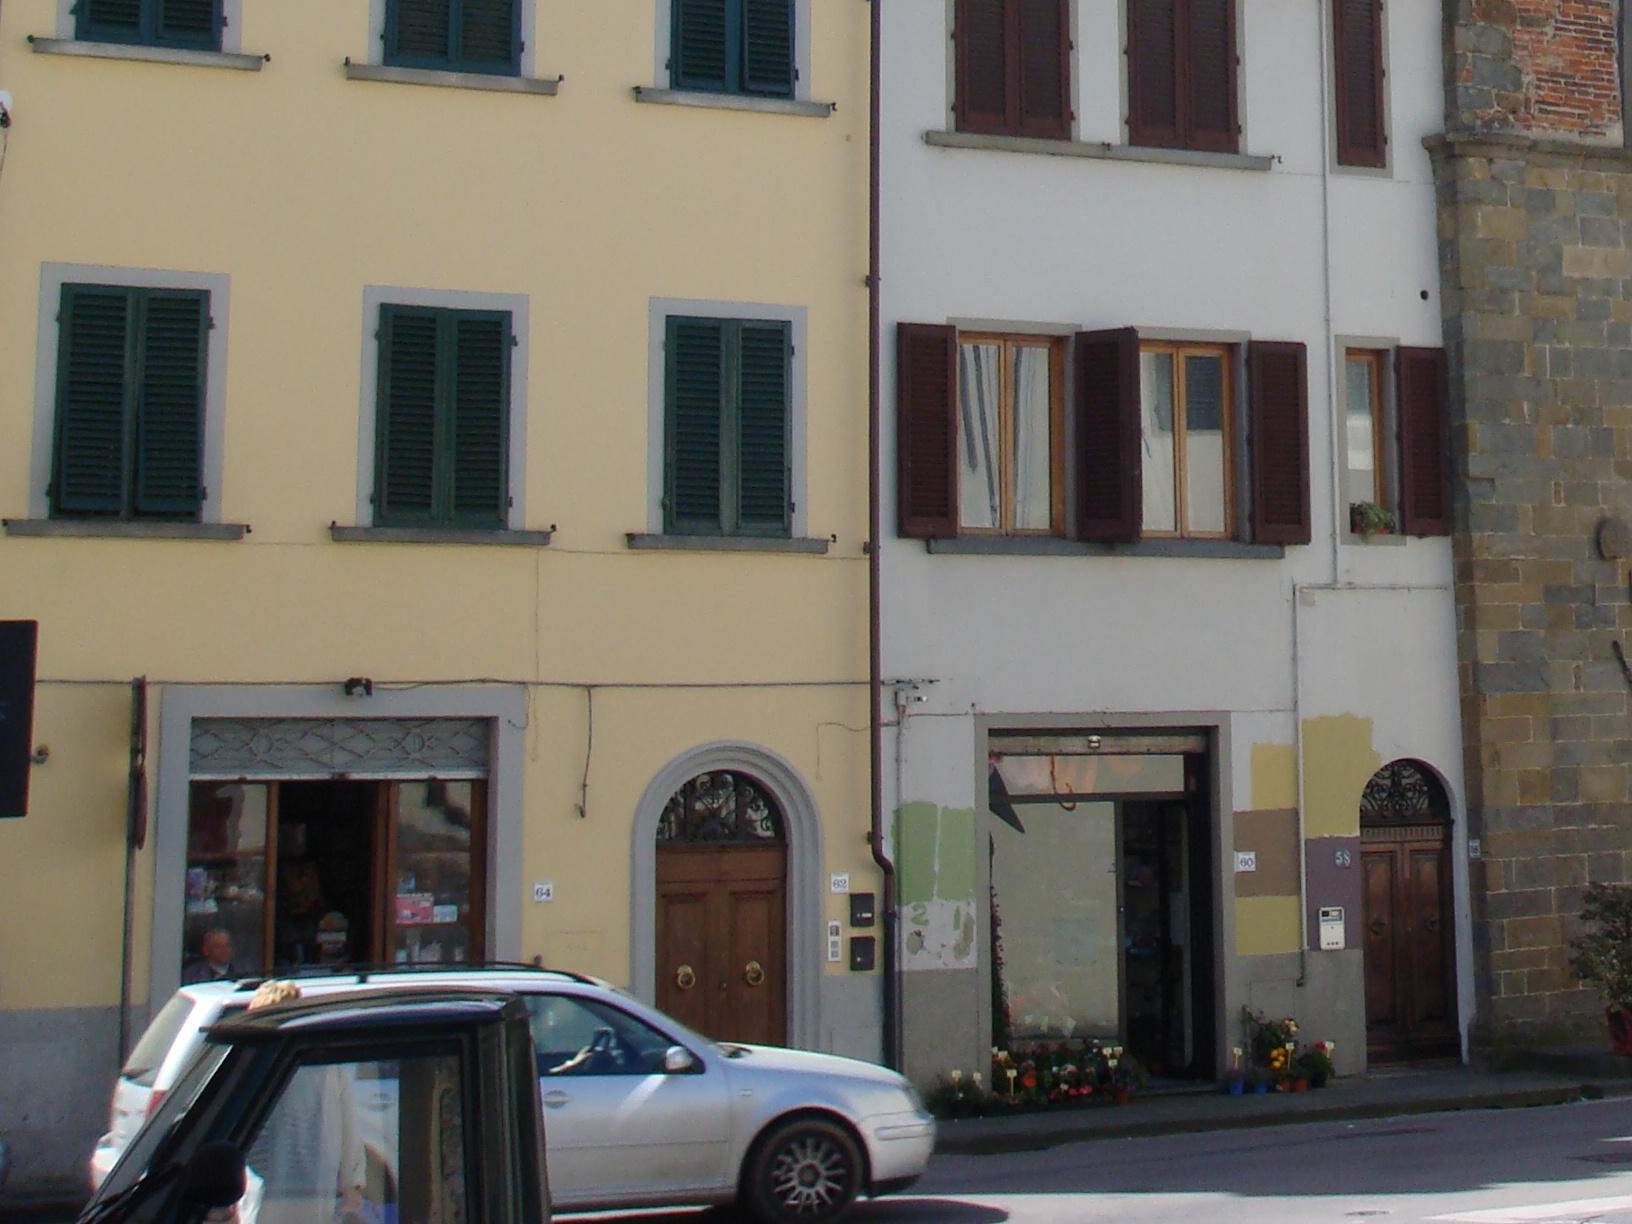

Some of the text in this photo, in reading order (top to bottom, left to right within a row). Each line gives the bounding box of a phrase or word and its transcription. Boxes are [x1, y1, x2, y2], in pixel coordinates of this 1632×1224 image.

[1240, 857, 1254, 867] 60
[832, 878, 847, 889] 62
[535, 887, 551, 898] 64
